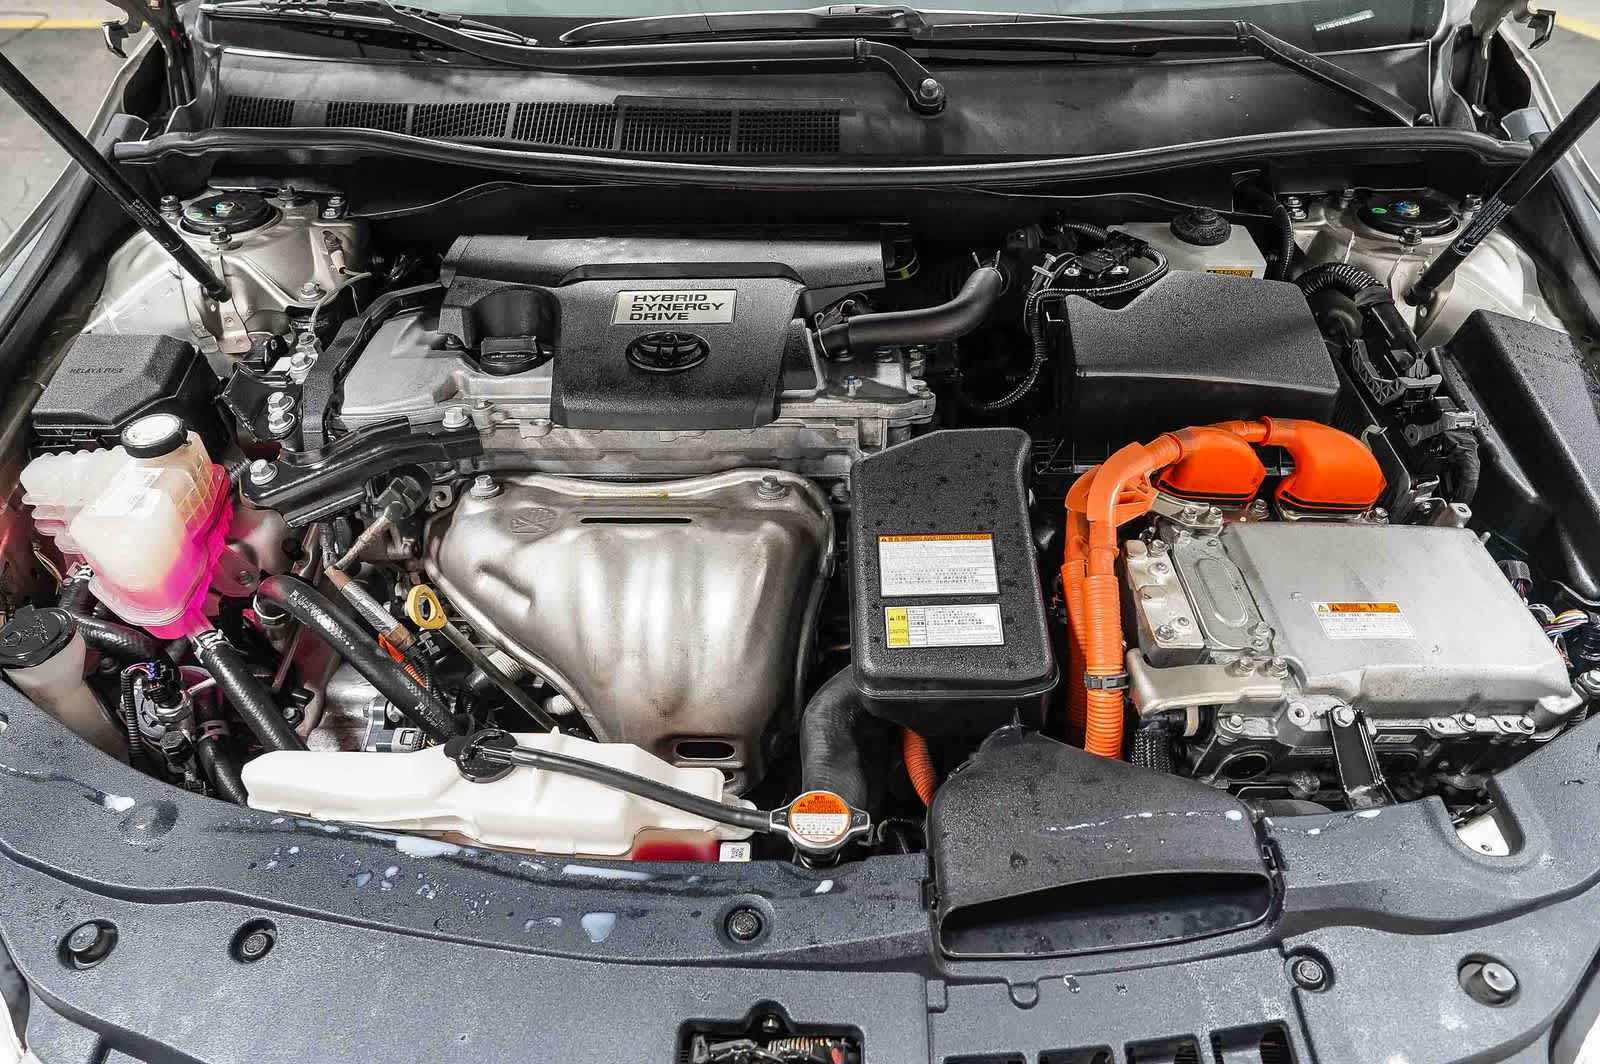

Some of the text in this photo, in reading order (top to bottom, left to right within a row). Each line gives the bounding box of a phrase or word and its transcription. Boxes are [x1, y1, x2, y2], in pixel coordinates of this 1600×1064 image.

[633, 294, 708, 302] HYBRID
[631, 302, 725, 311] SYNERGY
[629, 312, 690, 321] DRIVE
